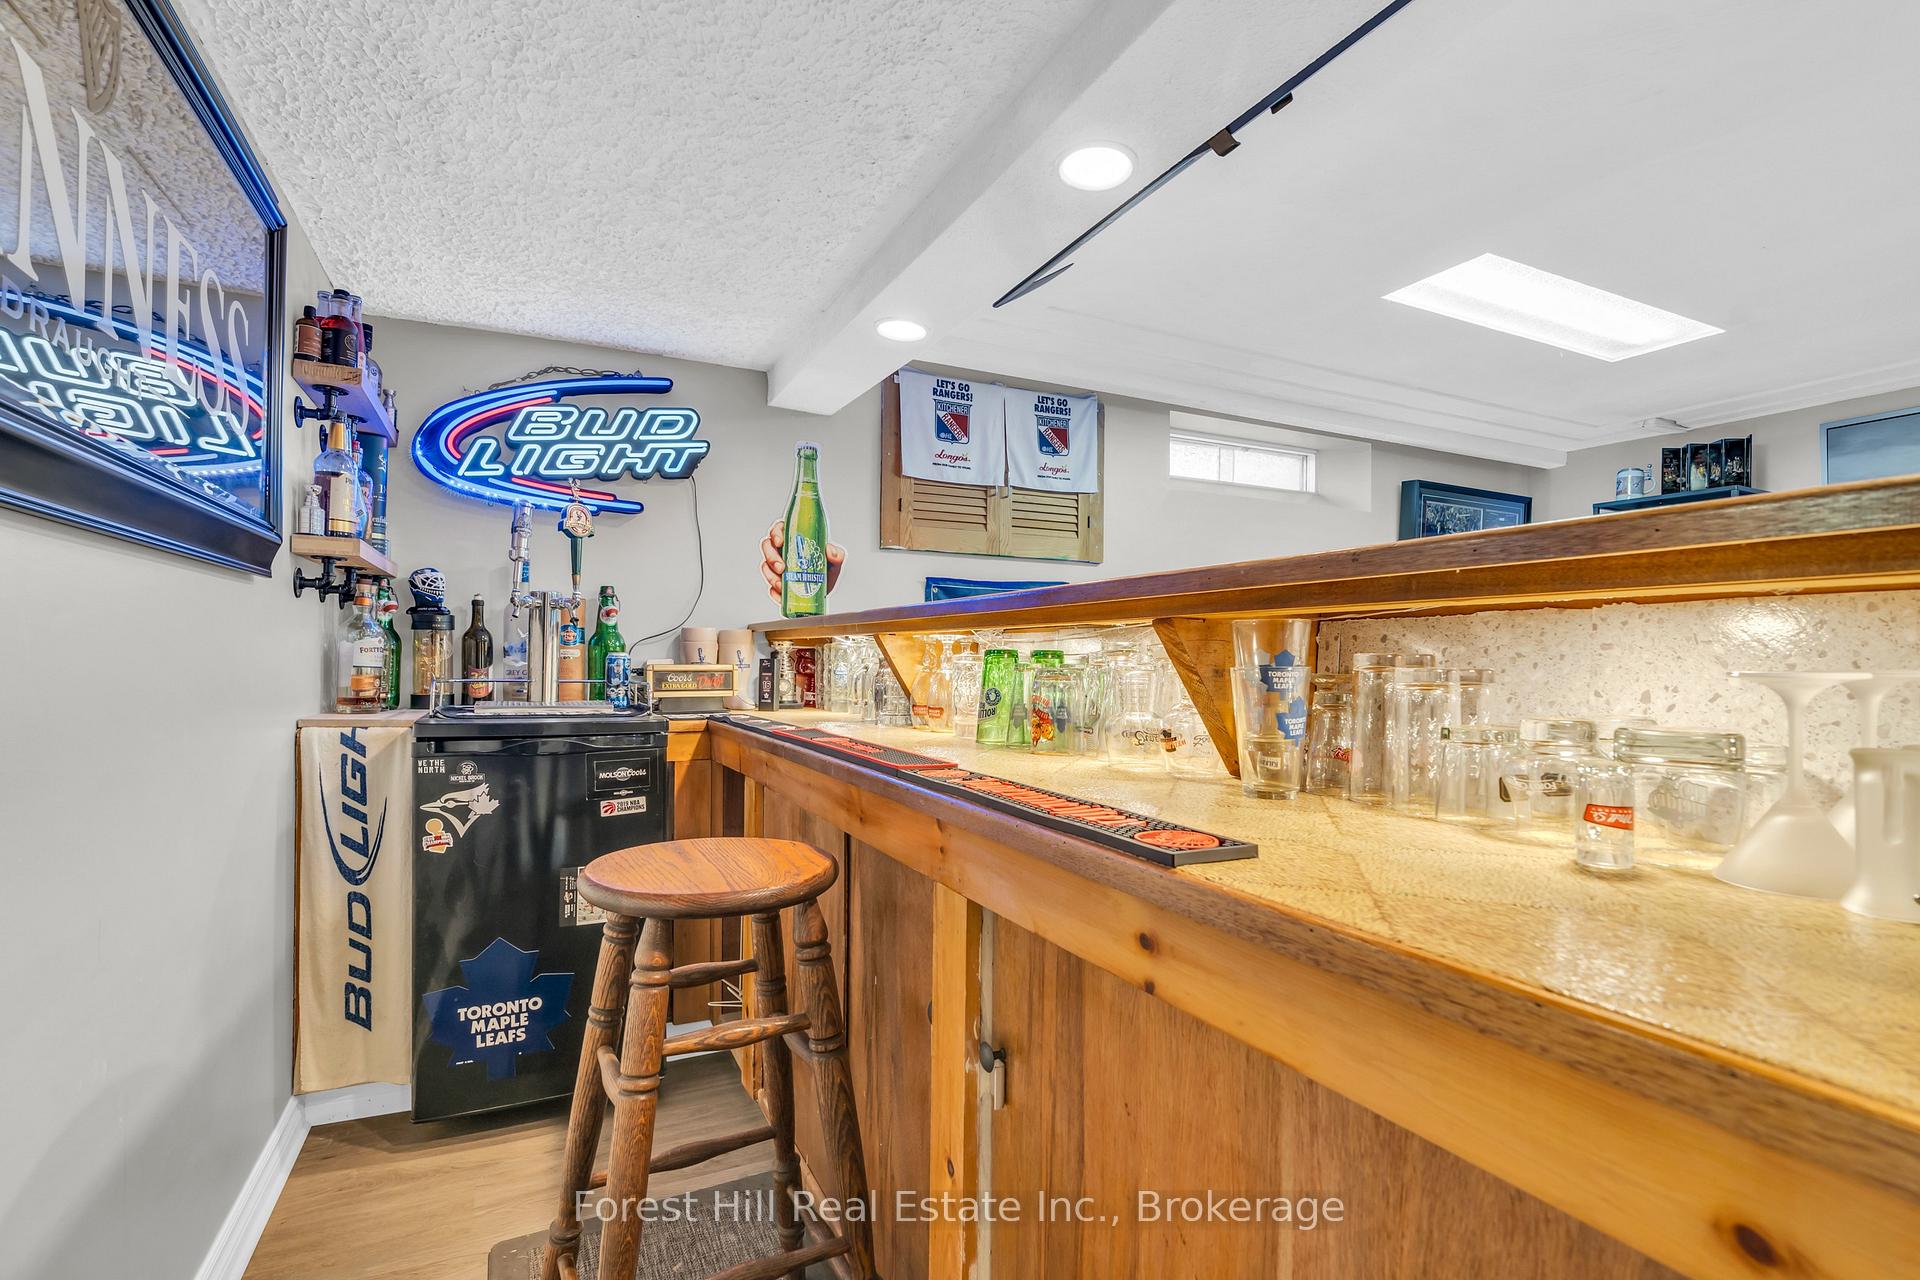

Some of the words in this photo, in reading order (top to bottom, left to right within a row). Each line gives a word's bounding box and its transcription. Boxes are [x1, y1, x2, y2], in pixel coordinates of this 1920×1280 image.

[1, 274, 147, 400] DRAUGHT
[936, 378, 956, 391] LET'S
[958, 382, 970, 393] GO
[932, 387, 973, 402] RANGERS!
[1037, 395, 1055, 406] LET'S
[1056, 398, 1068, 408] GO
[936, 401, 969, 415] KITCHENER
[1034, 404, 1071, 417] RANGERS!
[508, 406, 699, 441] BUD
[941, 412, 966, 442] RANGERS
[1038, 418, 1068, 428] KITCHENER
[1042, 427, 1067, 454] RANGERS
[457, 437, 709, 477] LIGHT
[802, 573, 824, 583] WHISTLE
[666, 673, 694, 682] Coors
[418, 766, 445, 774] NORTH
[430, 759, 445, 767] THE
[599, 770, 627, 779] MOLSON
[627, 768, 647, 777] Coors
[617, 804, 645, 813] CHAMPIONS
[344, 891, 373, 1032] BUD
[457, 996, 543, 1022] TORONTO
[470, 1012, 529, 1034] MAPLE
[476, 1028, 527, 1048] LEAFS
